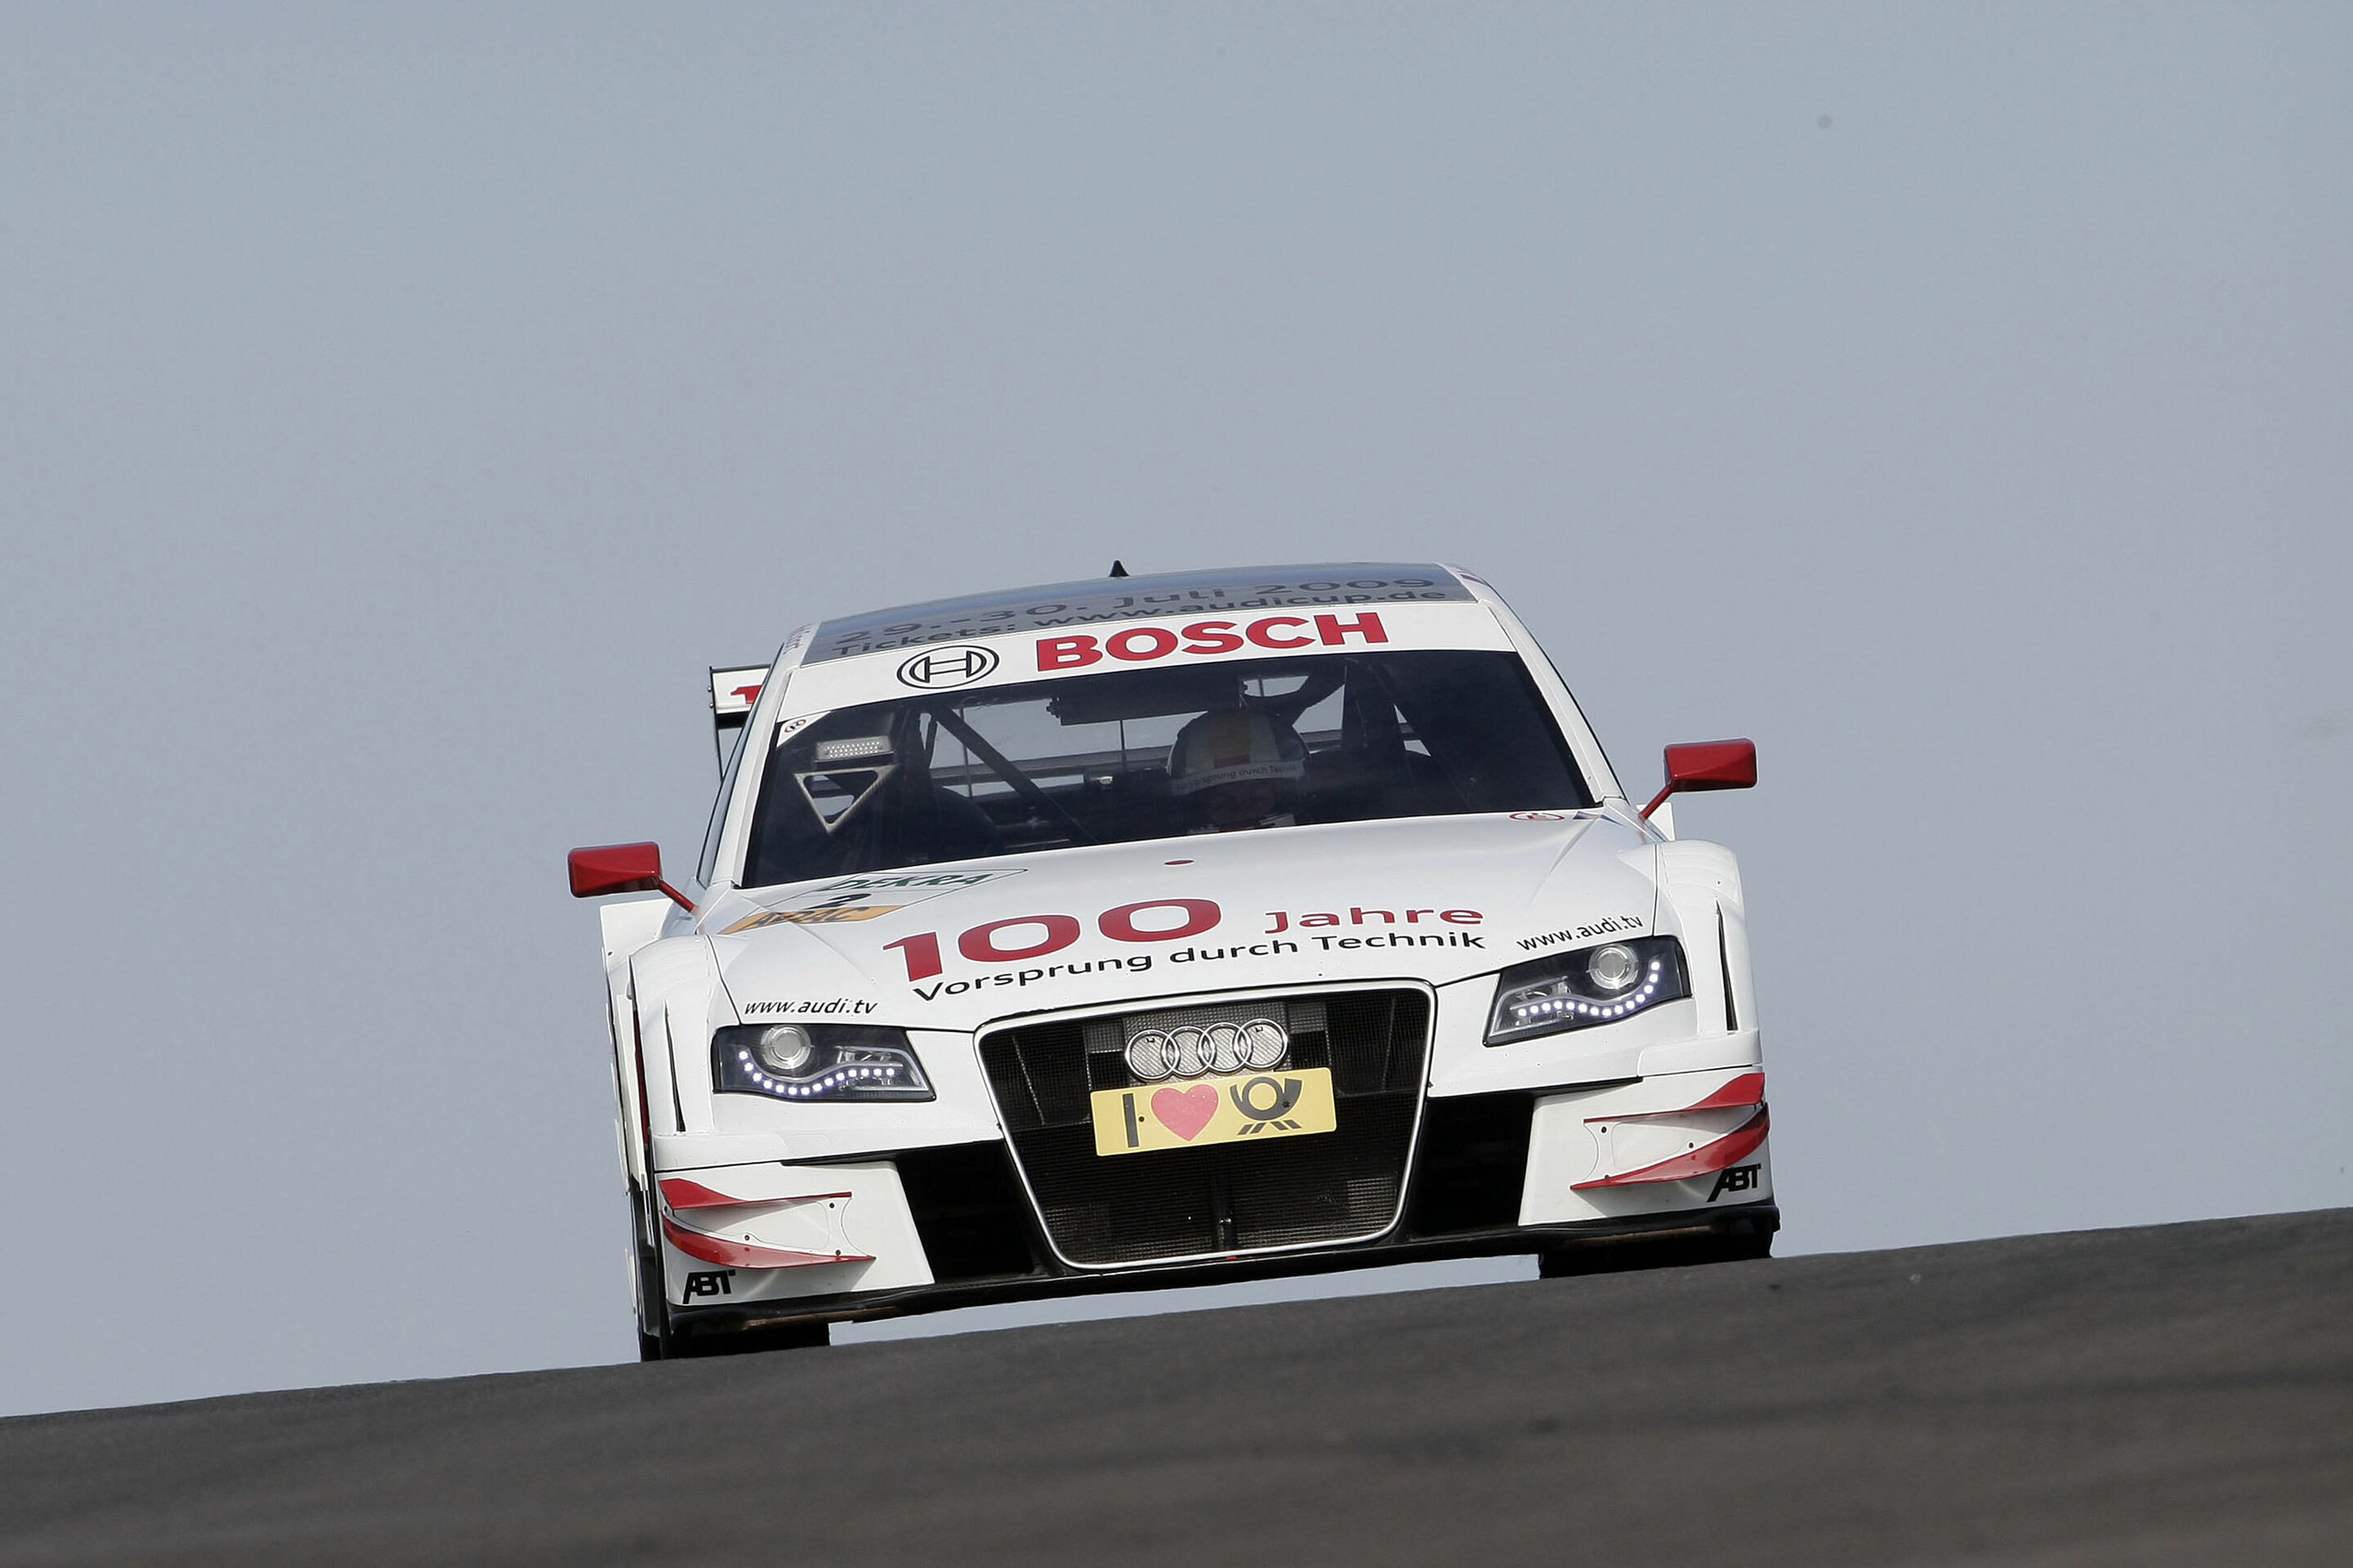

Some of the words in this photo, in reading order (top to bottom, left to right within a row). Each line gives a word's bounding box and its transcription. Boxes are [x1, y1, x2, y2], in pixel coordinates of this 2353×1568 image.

[1113, 587, 1224, 609] Juli
[1254, 579, 1434, 595] 2009
[833, 622, 1016, 654] Tickets:
[1034, 585, 1445, 627] www.audicup.de
[1036, 611, 1389, 672] BOSCH
[822, 873, 993, 891] DEKRA
[883, 899, 1221, 981] 100
[1265, 908, 1484, 933] Jahre
[1516, 915, 1643, 950] www.audi.tv
[913, 953, 1152, 1001] Vorsprung
[1169, 940, 1298, 963] durch
[1311, 932, 1486, 950] Technik
[744, 998, 877, 1015] www.audi.tv
[1706, 1164, 1761, 1202] ABT
[682, 1269, 735, 1304] ABT
